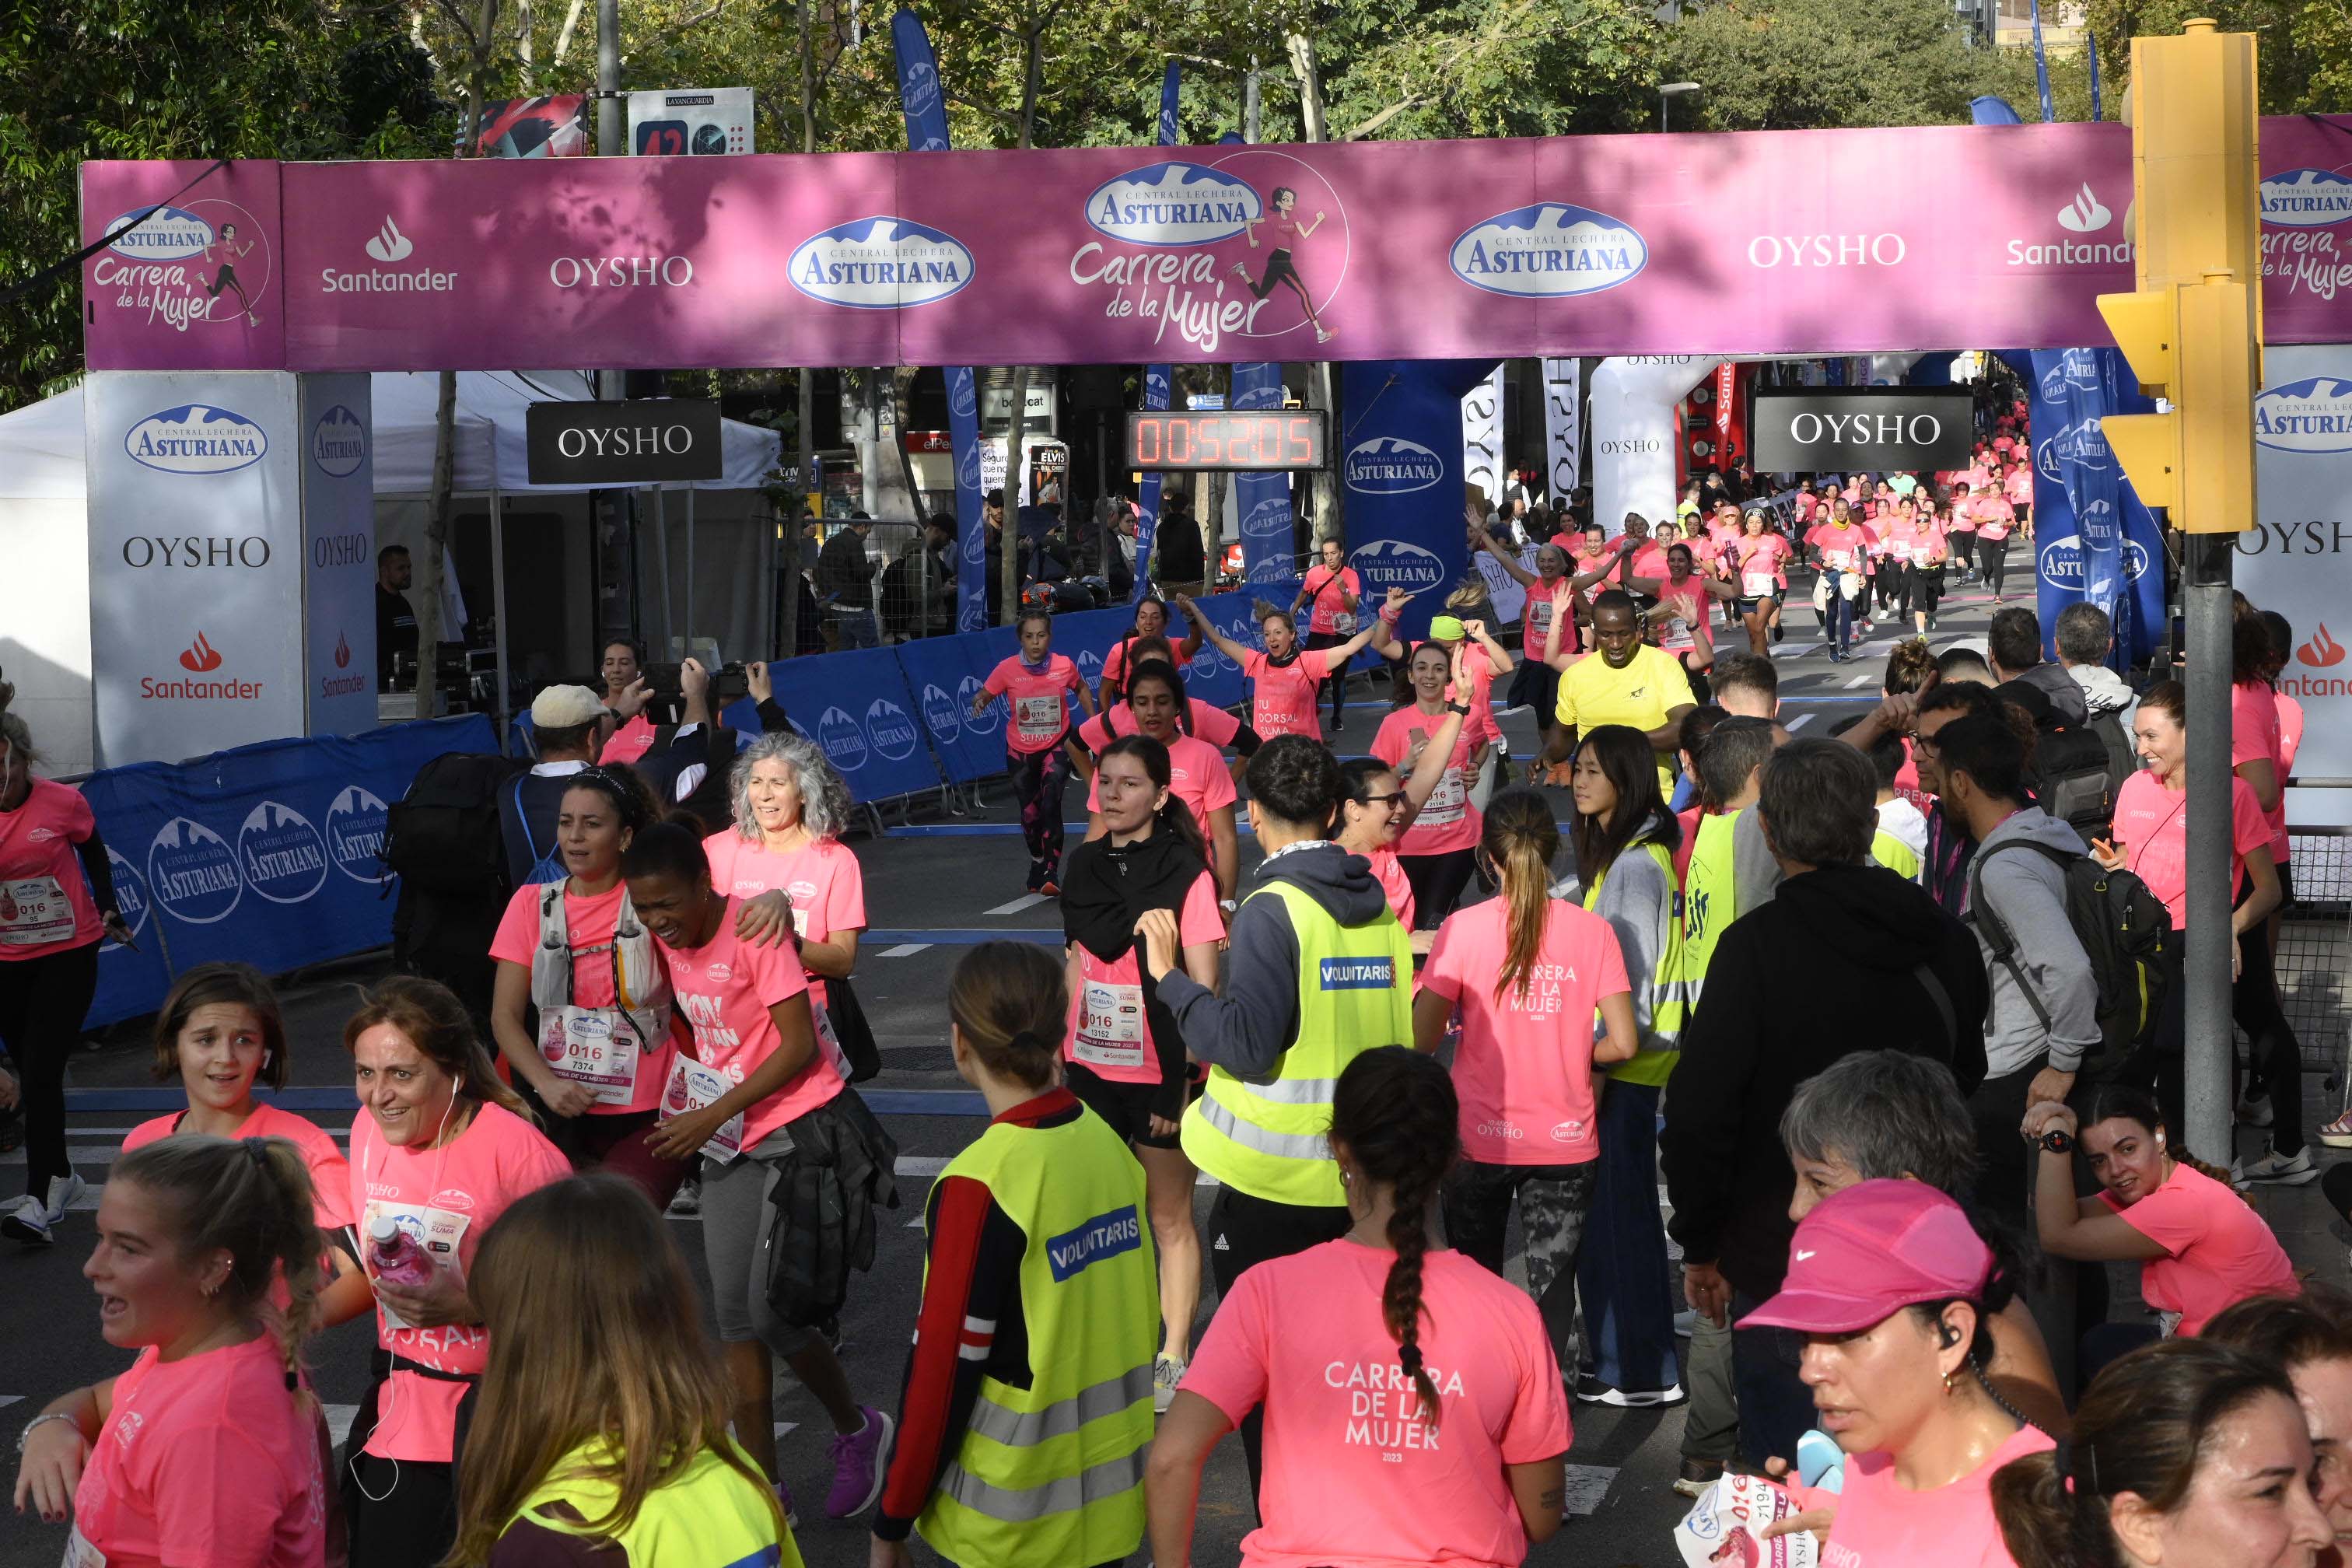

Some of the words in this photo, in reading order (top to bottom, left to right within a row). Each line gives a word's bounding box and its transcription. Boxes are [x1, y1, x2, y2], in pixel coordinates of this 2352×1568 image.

[1125, 191, 1181, 201] CENTRAL
[1187, 190, 1244, 199] LECHERA
[1098, 194, 1247, 226] ASTURIANA
[112, 226, 205, 247] ASTURIANA
[1495, 236, 1556, 246] CENTRAL
[1563, 234, 1626, 244] LECHERA
[2259, 231, 2335, 253] arrera
[830, 249, 891, 257] CENTRAL
[894, 248, 954, 257] LECHERA
[1465, 239, 1632, 274] ASTURIANA
[1748, 233, 1906, 268] OYSHO
[2007, 239, 2136, 265] Santand
[93, 257, 186, 285] Carrera
[550, 255, 693, 288] OYSHO
[802, 253, 960, 285] ASTURIANA
[1070, 242, 1214, 285] Carrera
[322, 267, 457, 292] Santander
[2278, 261, 2292, 276] la
[2290, 250, 2352, 300] Muje
[117, 288, 135, 307] de
[137, 286, 149, 307] la
[148, 282, 221, 331] Mujer
[1106, 289, 1133, 317] de
[1139, 289, 1157, 317] la
[1154, 281, 1269, 352] Mujer
[2277, 404, 2330, 412] CENTRAL
[1791, 413, 1941, 445] OYSHO
[136, 431, 257, 457] ASTURIANA
[317, 436, 362, 460] ASTURIANA
[558, 425, 693, 457] OYSHO
[1139, 418, 1312, 463] 00:52:05
[1601, 439, 1660, 455] OYSHO
[1041, 453, 1065, 462] ELVIS
[1348, 460, 1437, 481] ASTURIANA
[122, 537, 270, 568] OYSHO
[315, 533, 366, 568] OYSHO
[141, 677, 263, 699] Santander
[322, 672, 366, 698] Santander
[1258, 699, 1269, 710] TU
[1258, 713, 1298, 723] DORSAL
[1020, 733, 1054, 743] SUMA
[1260, 726, 1290, 736] SUMA
[246, 843, 324, 883] ASTURIANA
[157, 861, 239, 902] ASTURIANA
[20, 903, 46, 915] 016
[1321, 964, 1391, 982] VOLUNTARIS
[1542, 982, 1561, 996] LA
[1510, 996, 1563, 1013] MUJER
[571, 1022, 607, 1034] ASTURIANA
[1090, 1013, 1112, 1027] 016
[1091, 1029, 1109, 1038] 13152
[569, 1043, 603, 1059] 016
[572, 1061, 593, 1071] 7374
[691, 1076, 719, 1096] ASTURIANA
[689, 1097, 705, 1110] 01
[1478, 1124, 1523, 1140] OYSHO
[430, 1226, 454, 1234] SUMA
[1052, 1217, 1139, 1269] VOLUNTARIS
[1352, 1391, 1386, 1418] DE
[1345, 1419, 1440, 1450] MUJER
[1382, 1452, 1402, 1463] 2023
[1731, 1475, 1751, 1522] 016
[1779, 1492, 1787, 1505] LA
